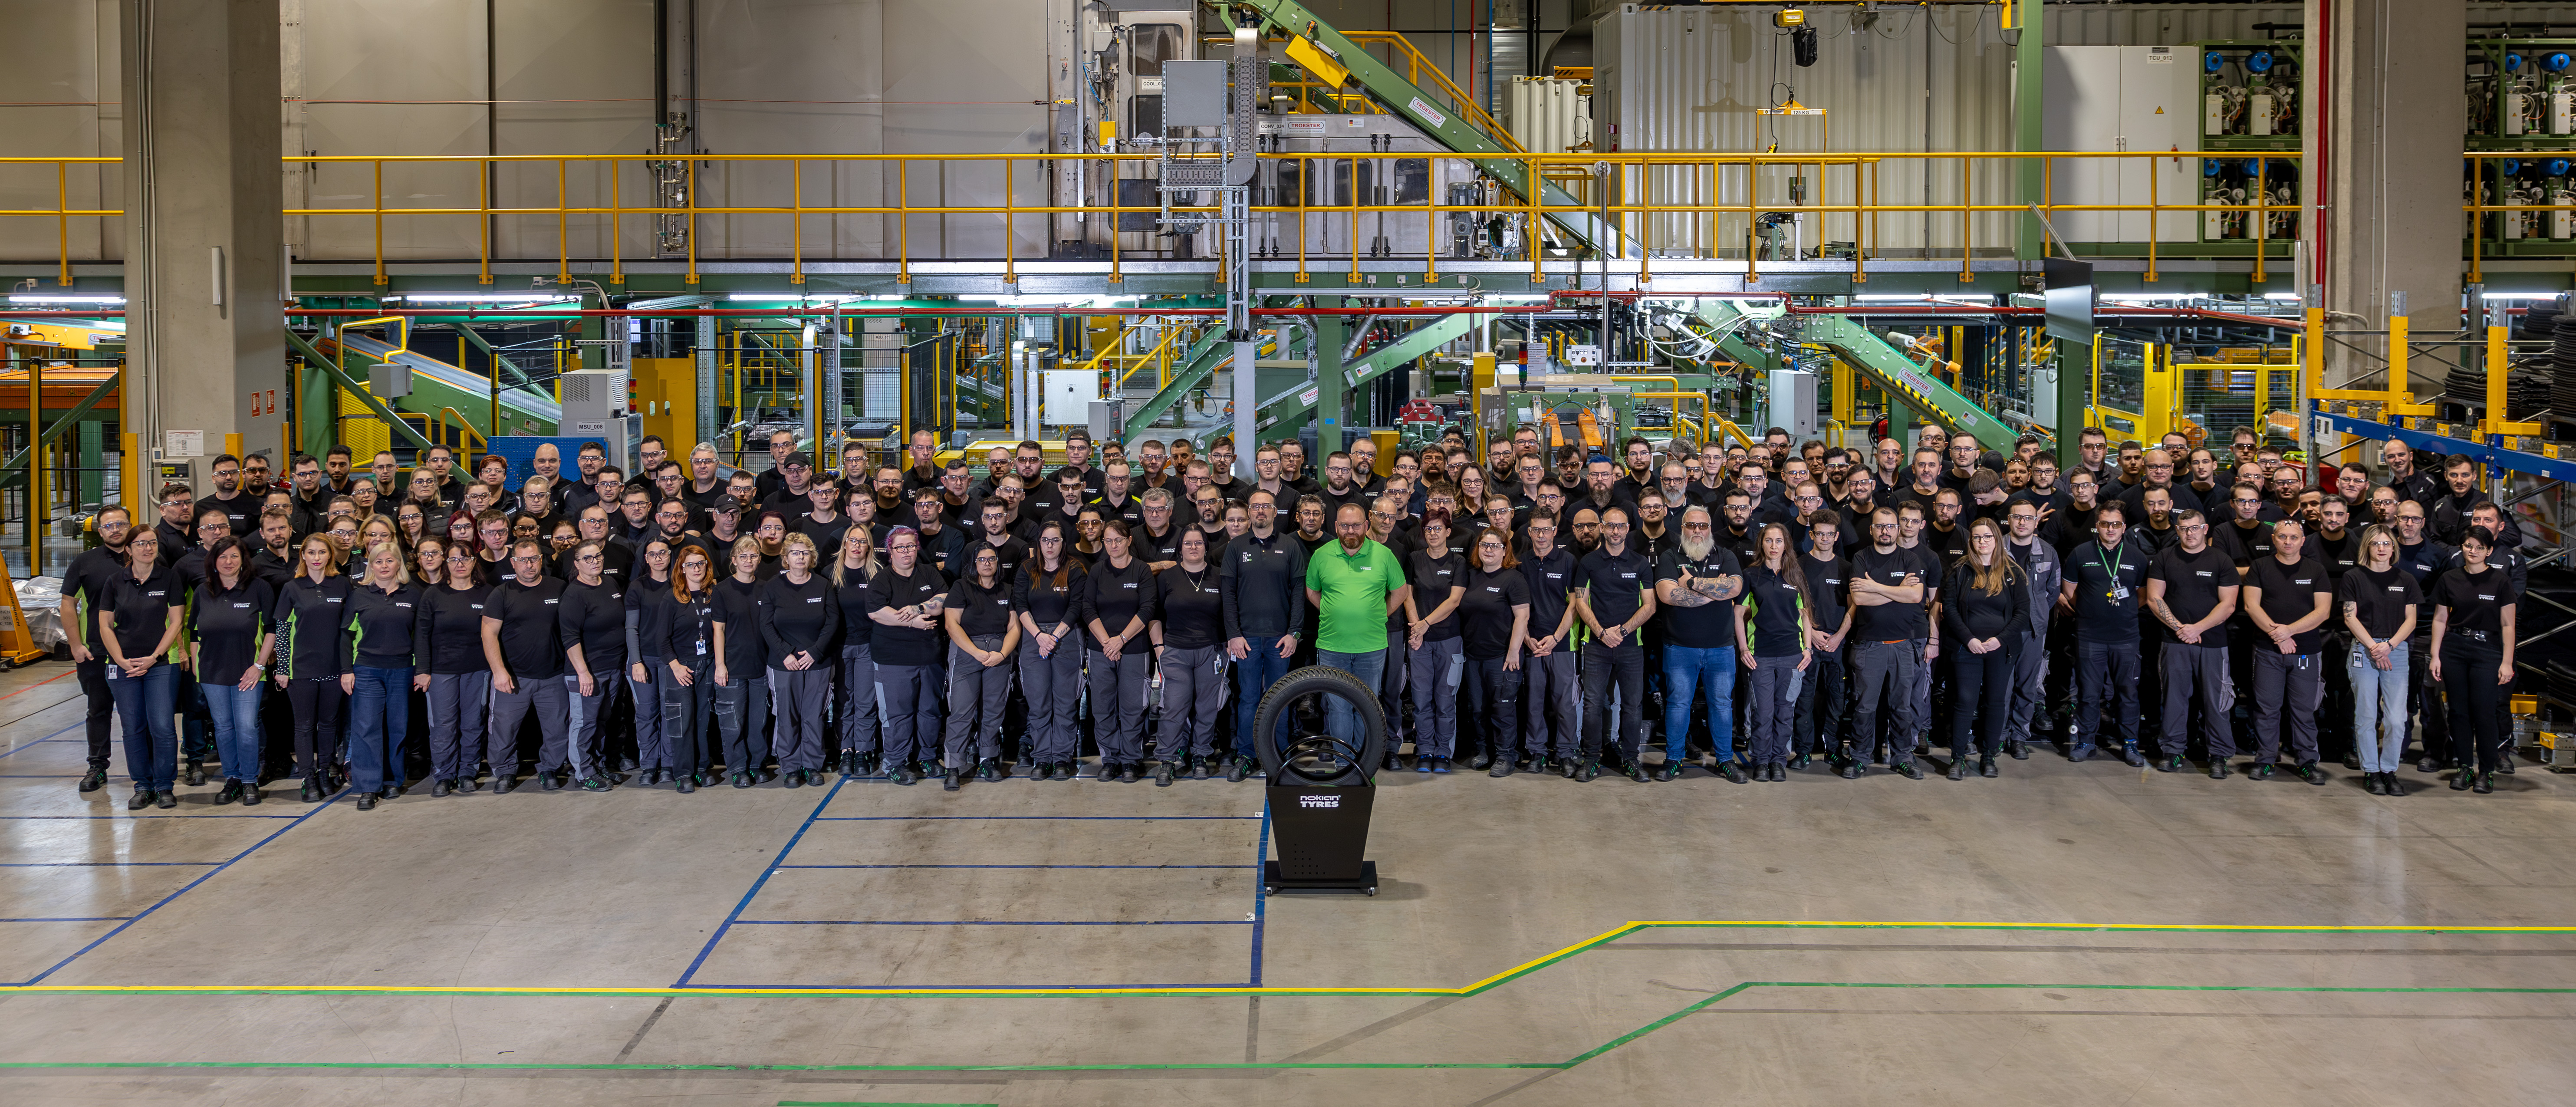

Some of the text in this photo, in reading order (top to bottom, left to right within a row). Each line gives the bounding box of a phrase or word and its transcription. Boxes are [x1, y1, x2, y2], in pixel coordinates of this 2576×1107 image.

[1416, 102, 1440, 121] TROESTER
[1903, 372, 1928, 390] TROESTER
[1305, 390, 1318, 399] TROE
